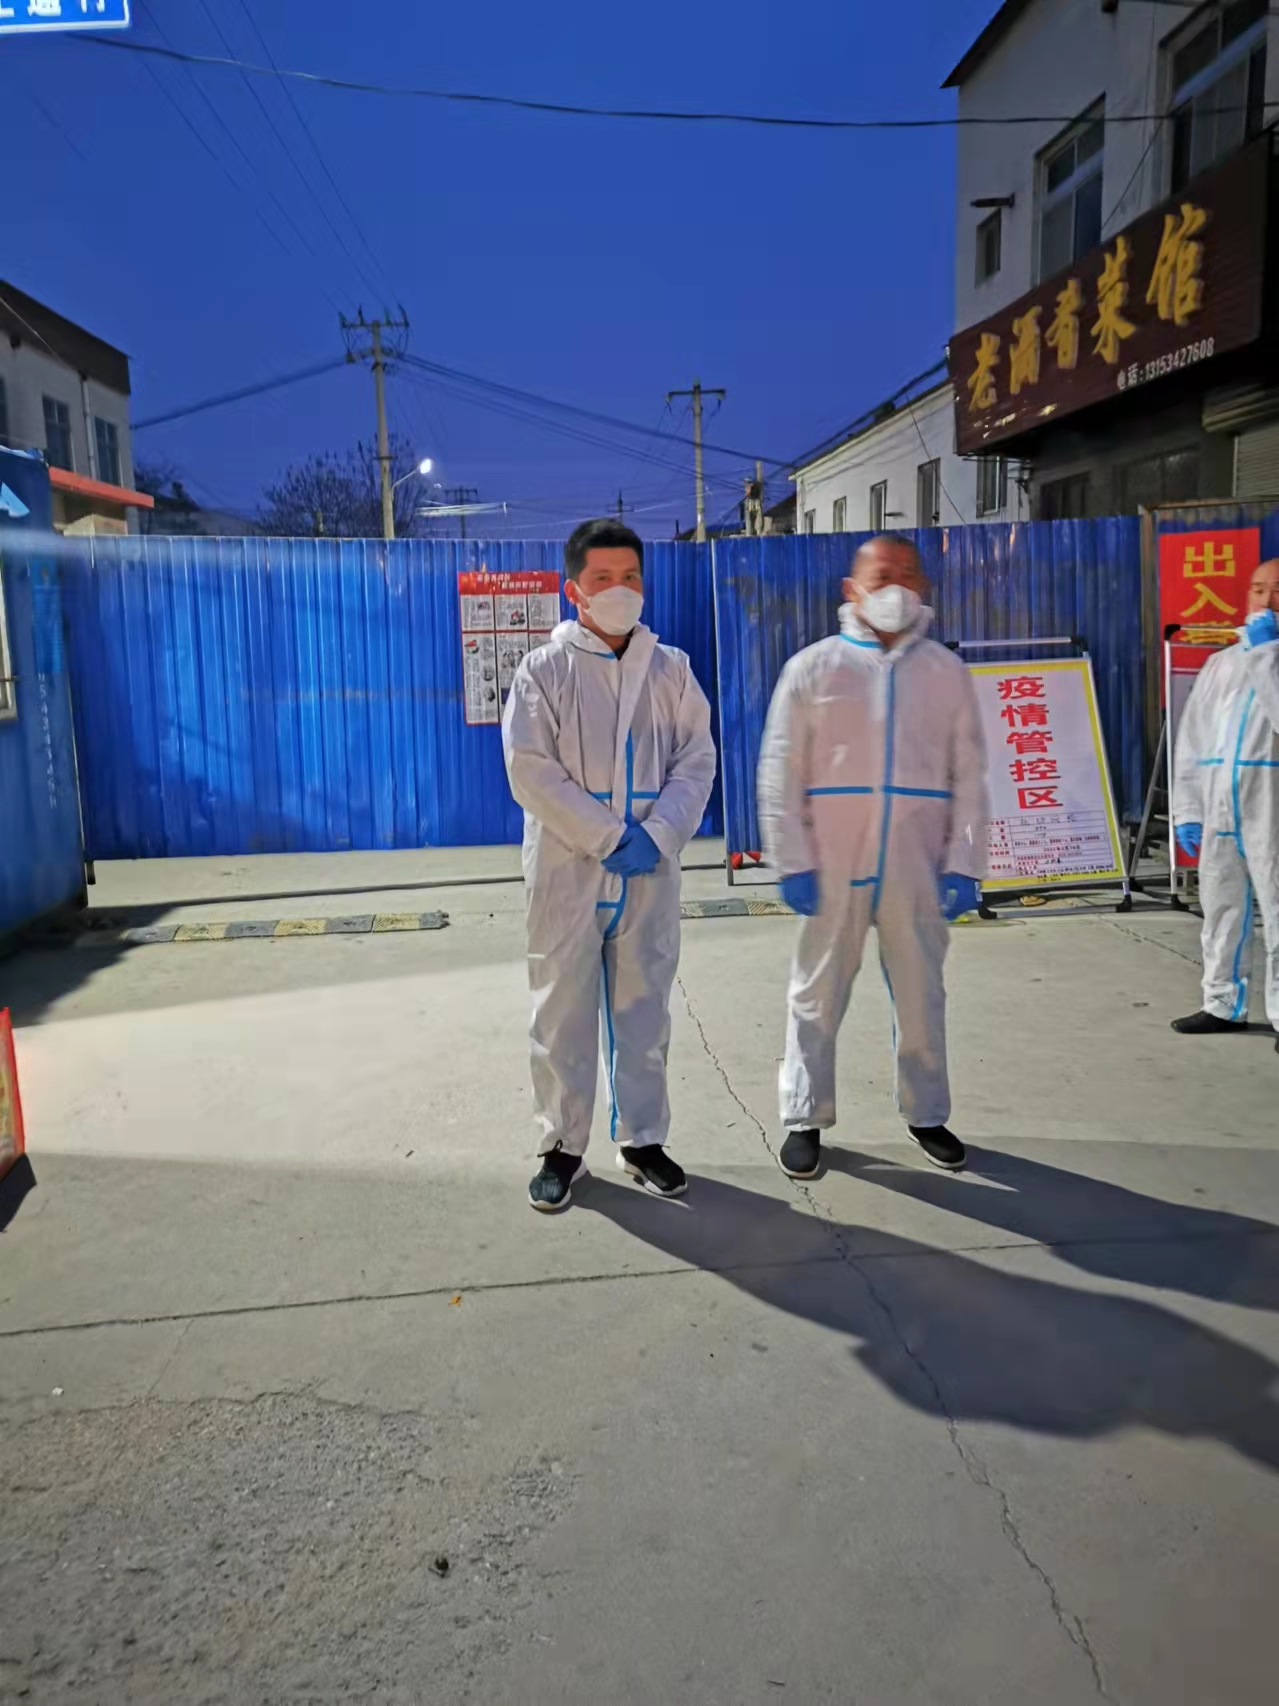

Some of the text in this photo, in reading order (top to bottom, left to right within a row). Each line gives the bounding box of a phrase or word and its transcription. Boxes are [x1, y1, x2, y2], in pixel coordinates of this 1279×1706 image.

[997, 676, 1063, 809] 疫情管控区
